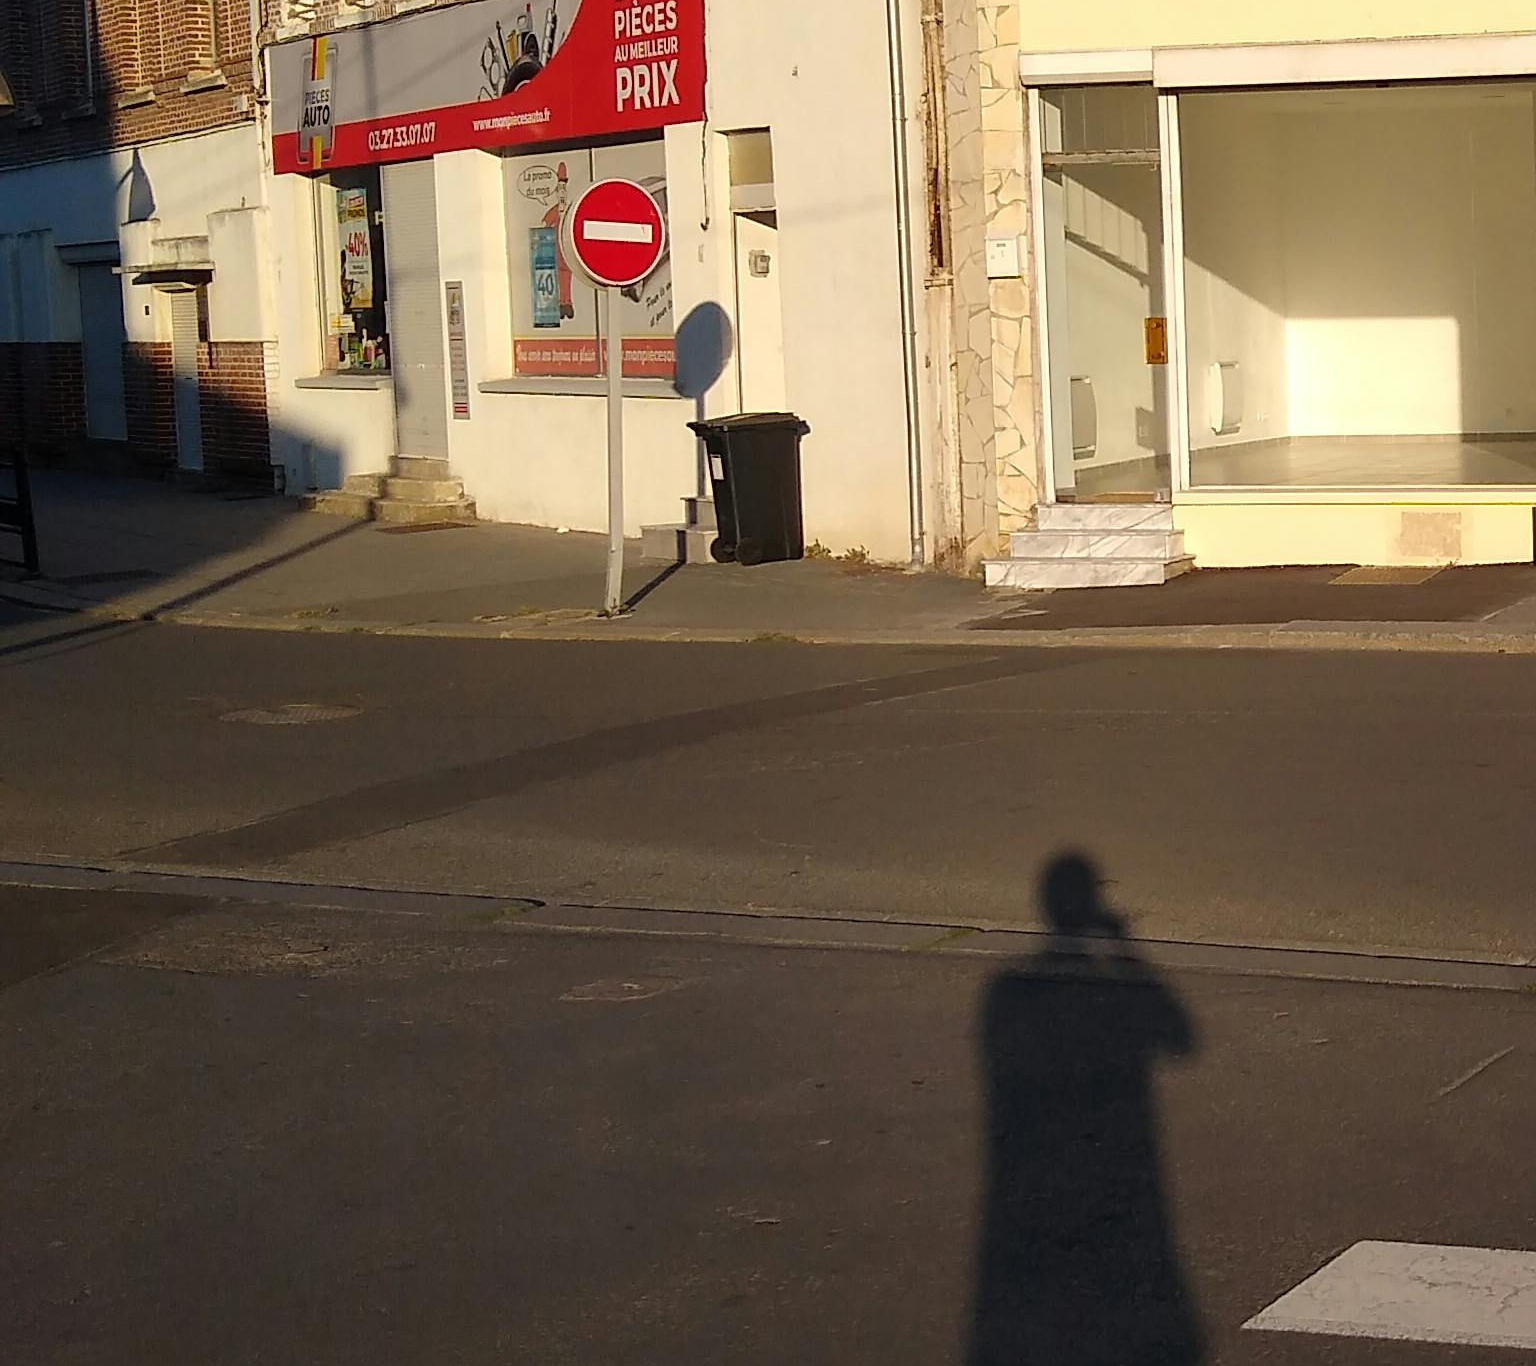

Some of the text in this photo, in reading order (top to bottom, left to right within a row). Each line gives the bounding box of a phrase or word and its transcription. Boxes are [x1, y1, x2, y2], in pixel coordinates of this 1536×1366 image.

[614, 36, 678, 62] AU MEILLEUR
[616, 59, 680, 112] PRIX
[303, 104, 330, 128] AUTO
